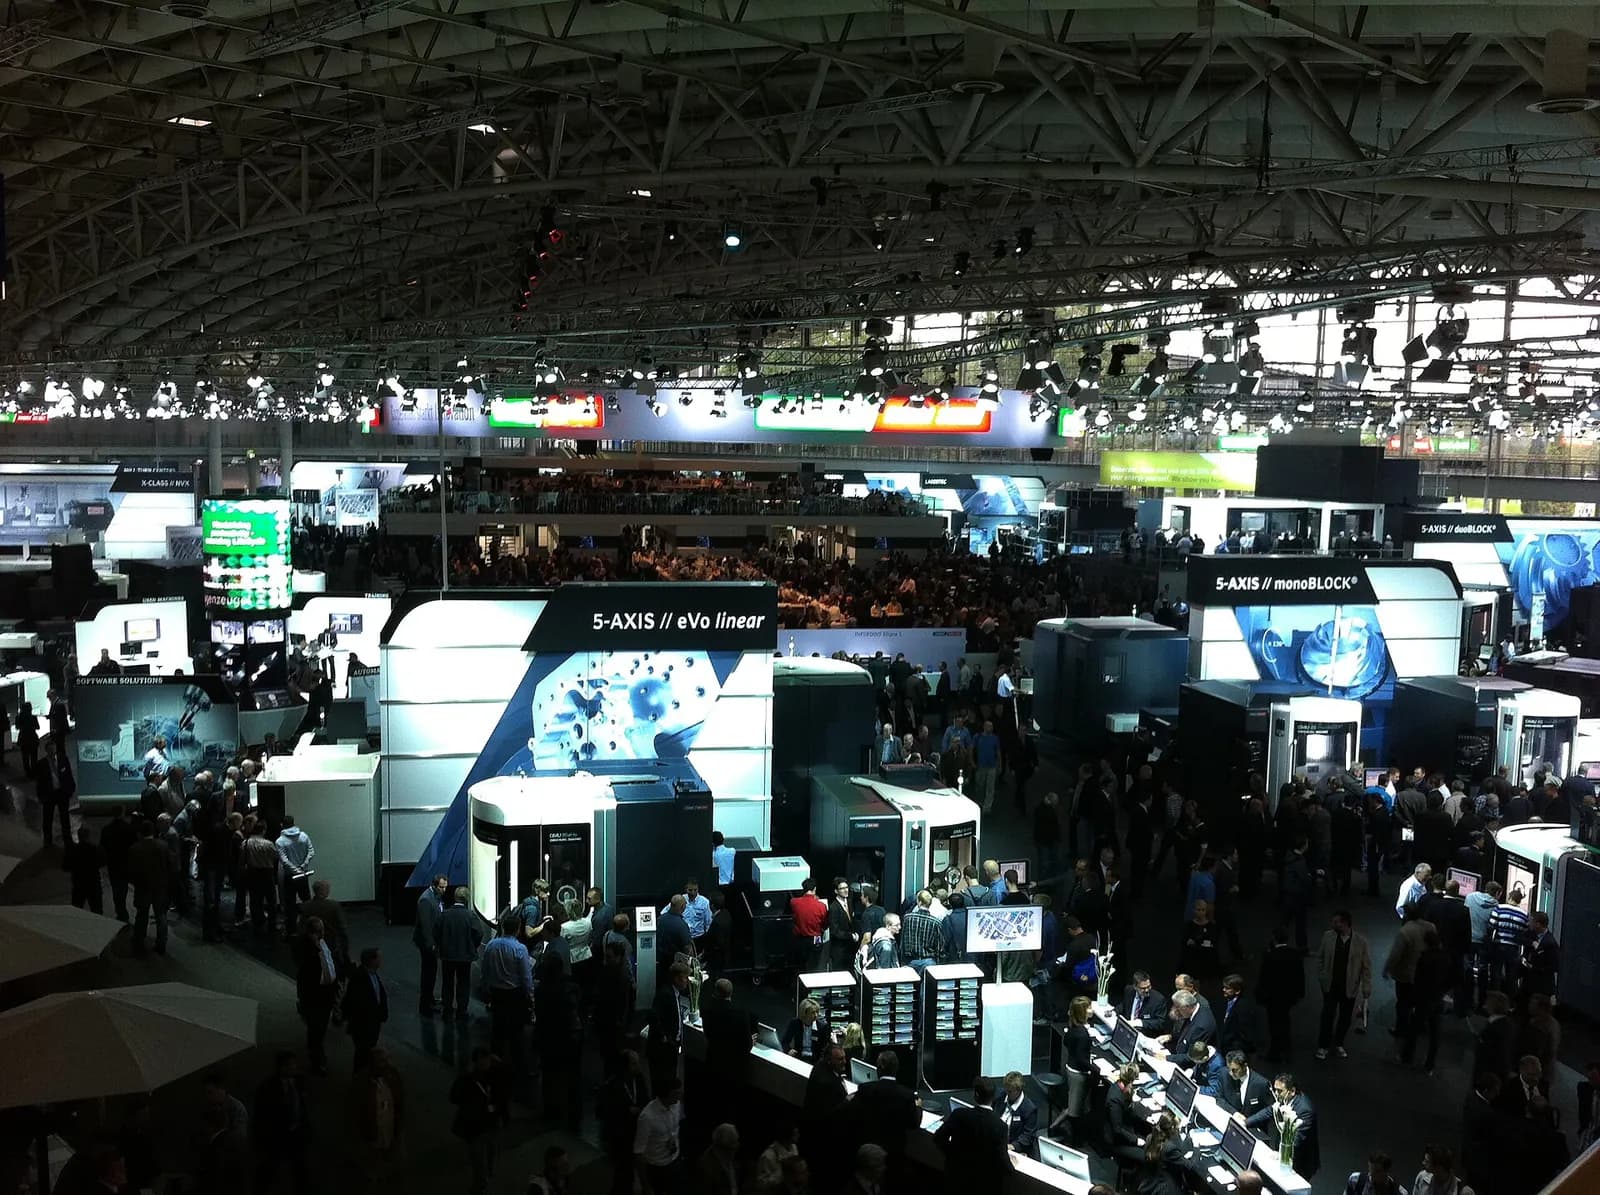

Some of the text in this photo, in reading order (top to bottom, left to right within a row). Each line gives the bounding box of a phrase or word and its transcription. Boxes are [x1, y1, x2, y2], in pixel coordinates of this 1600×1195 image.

[1421, 524, 1446, 533] 5-AXIS
[1216, 576, 1260, 590] 5-AXIS
[1262, 577, 1273, 590] //
[593, 611, 766, 630] 5-AXIS // eVo linear
